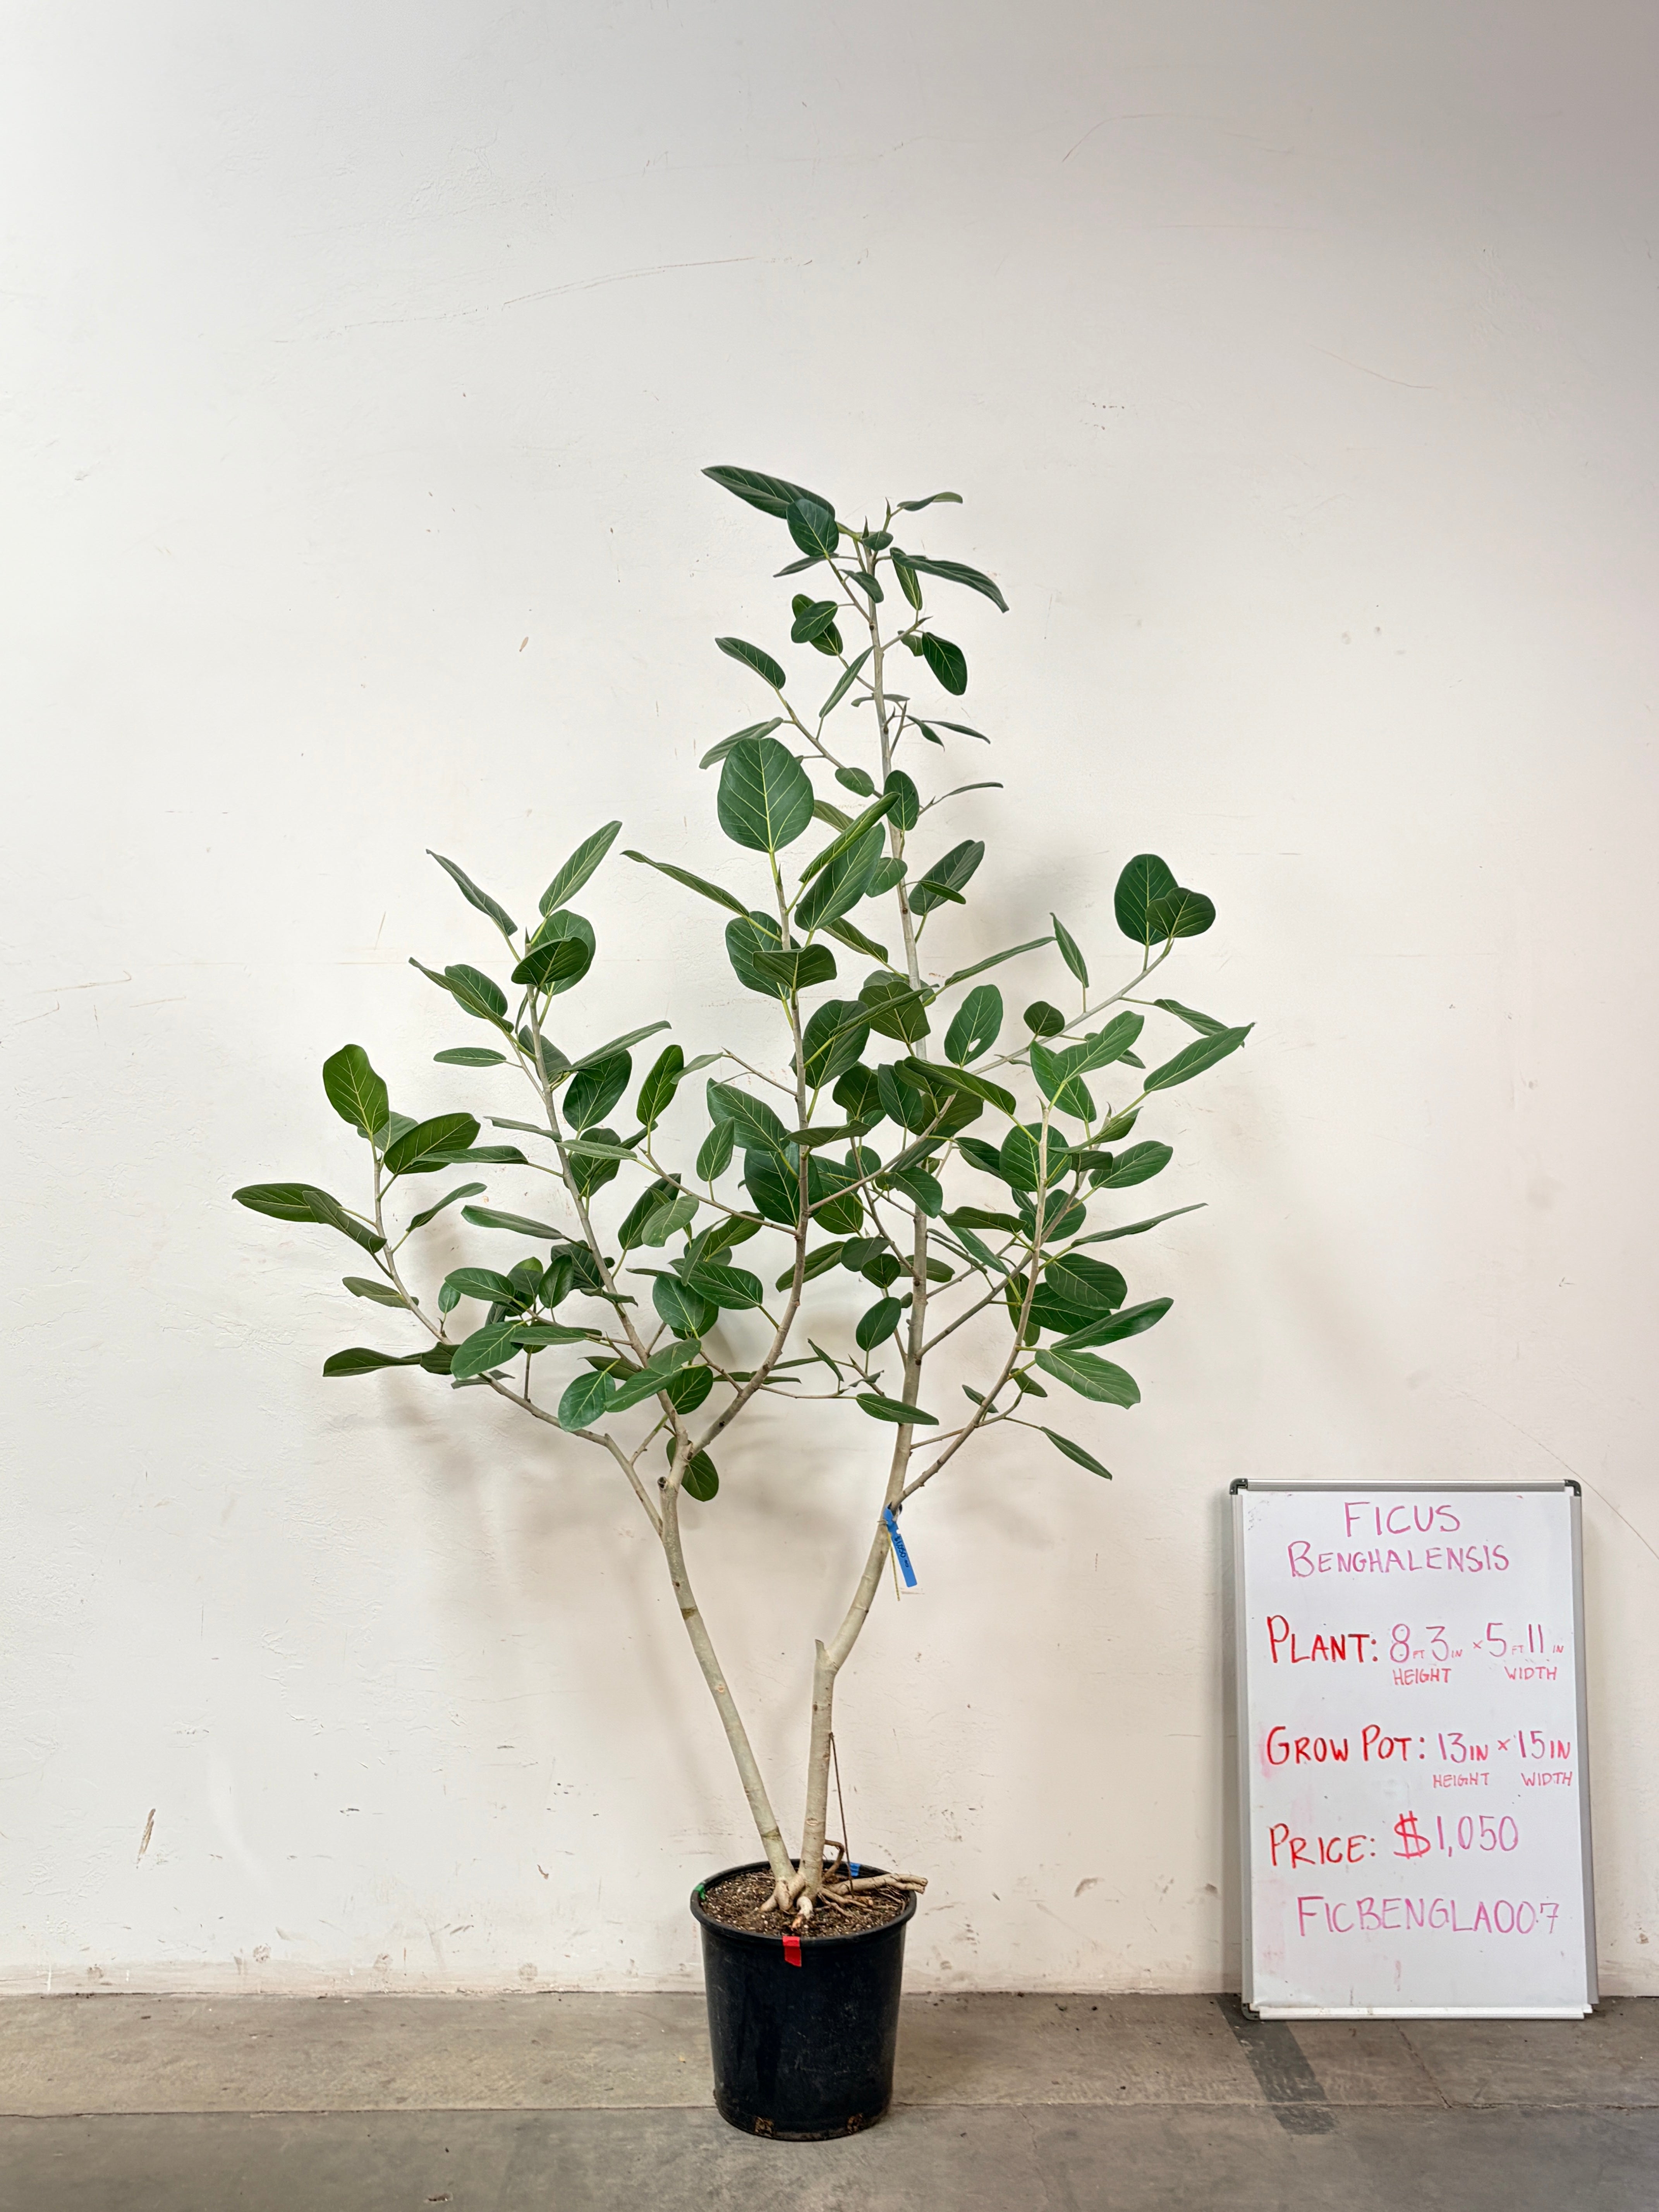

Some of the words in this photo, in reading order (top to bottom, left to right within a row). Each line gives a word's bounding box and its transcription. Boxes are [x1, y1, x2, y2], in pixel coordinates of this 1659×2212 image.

[1345, 1501, 1461, 1537] FICUS
[1287, 1540, 1510, 1578] BENGHALENSIS
[1266, 1614, 1378, 1664] PLANT:
[1393, 1668, 1451, 1686] HEIGHT
[1505, 1666, 1558, 1680] WIDTH
[1266, 1726, 1349, 1765] GROW
[1361, 1724, 1425, 1762] POT:
[1433, 1772, 1490, 1788] HEIGHT
[1521, 1771, 1573, 1787] WIDTH
[1269, 1822, 1376, 1869] PRICE:
[1393, 1810, 1519, 1860] $1,050
